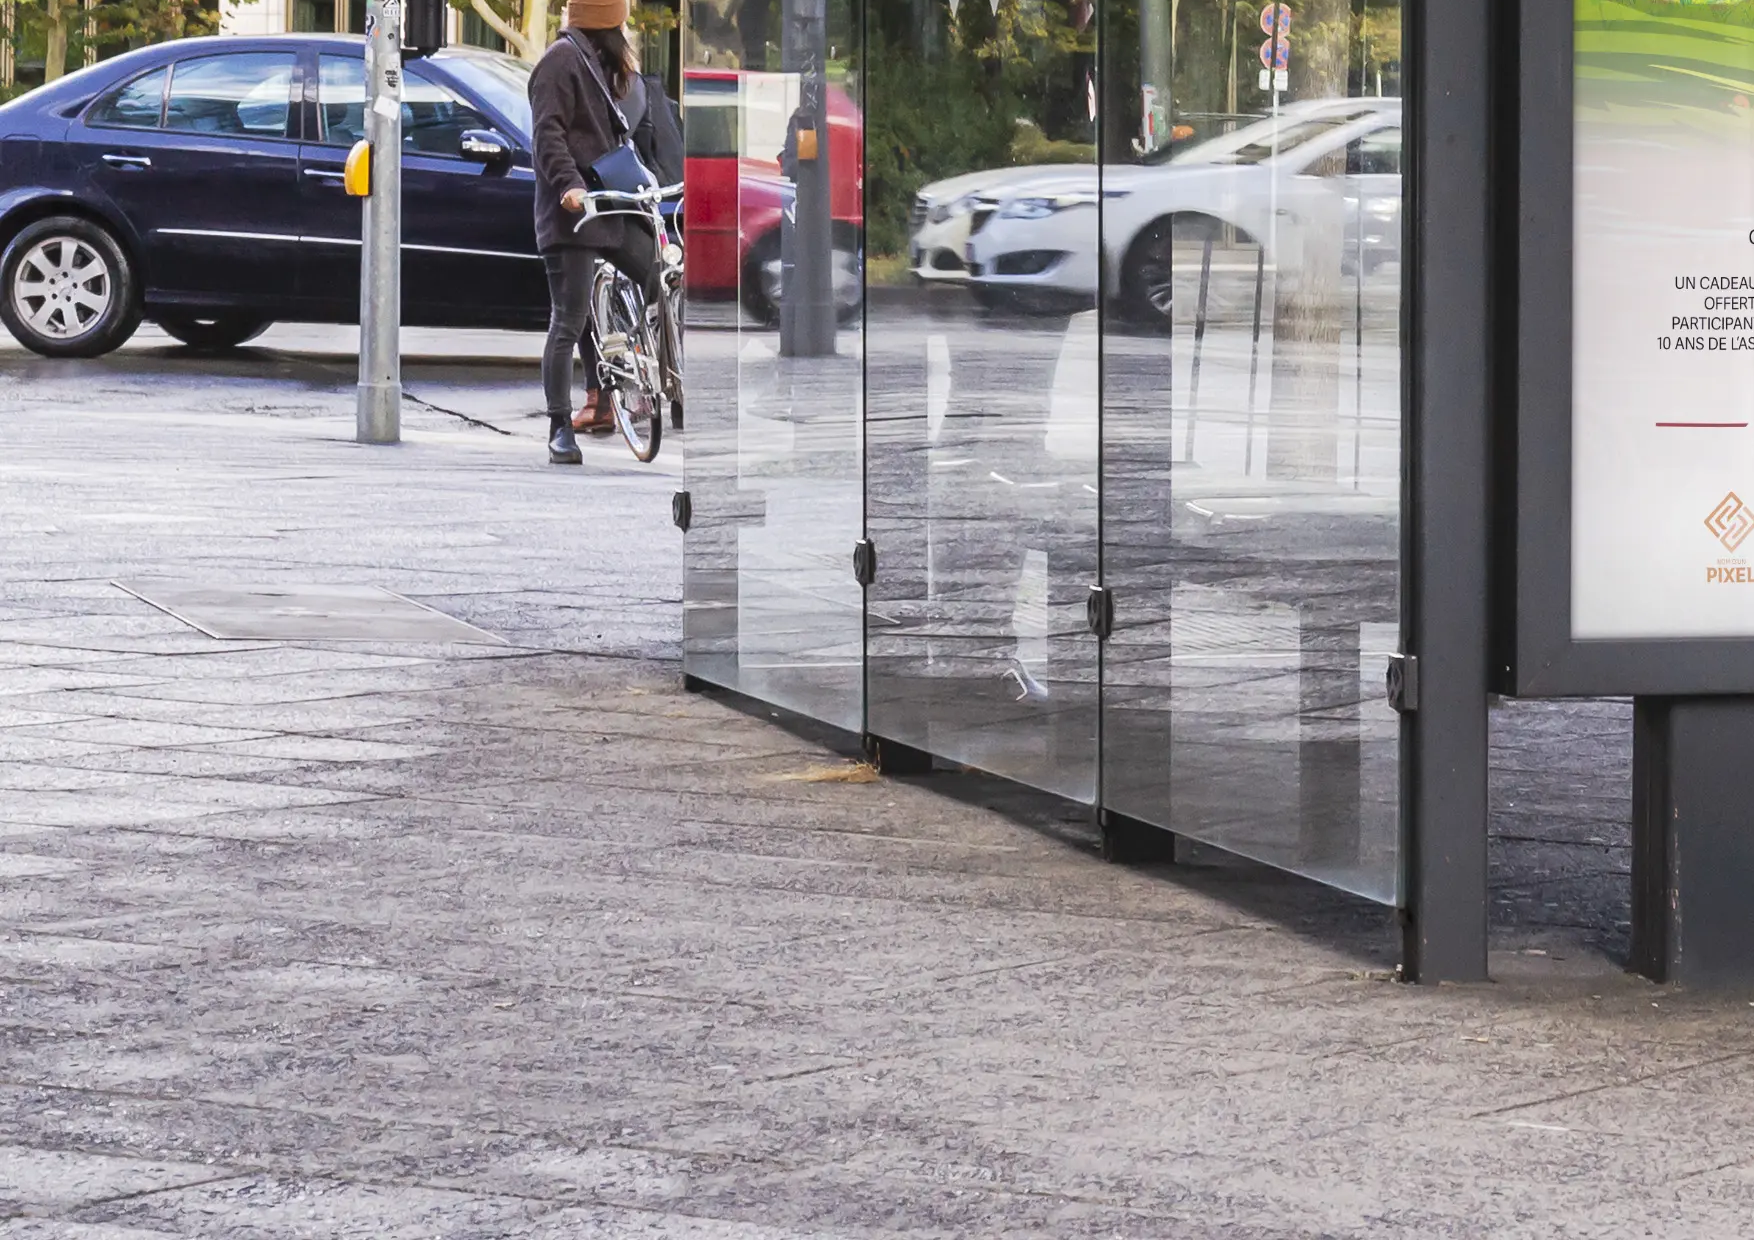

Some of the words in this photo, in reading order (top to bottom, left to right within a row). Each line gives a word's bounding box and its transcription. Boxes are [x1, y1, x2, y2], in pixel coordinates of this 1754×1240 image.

[1675, 276, 1695, 289] UN
[1658, 337, 1671, 350] 10
[1675, 337, 1704, 350] ANS
[1709, 337, 1726, 350] DE
